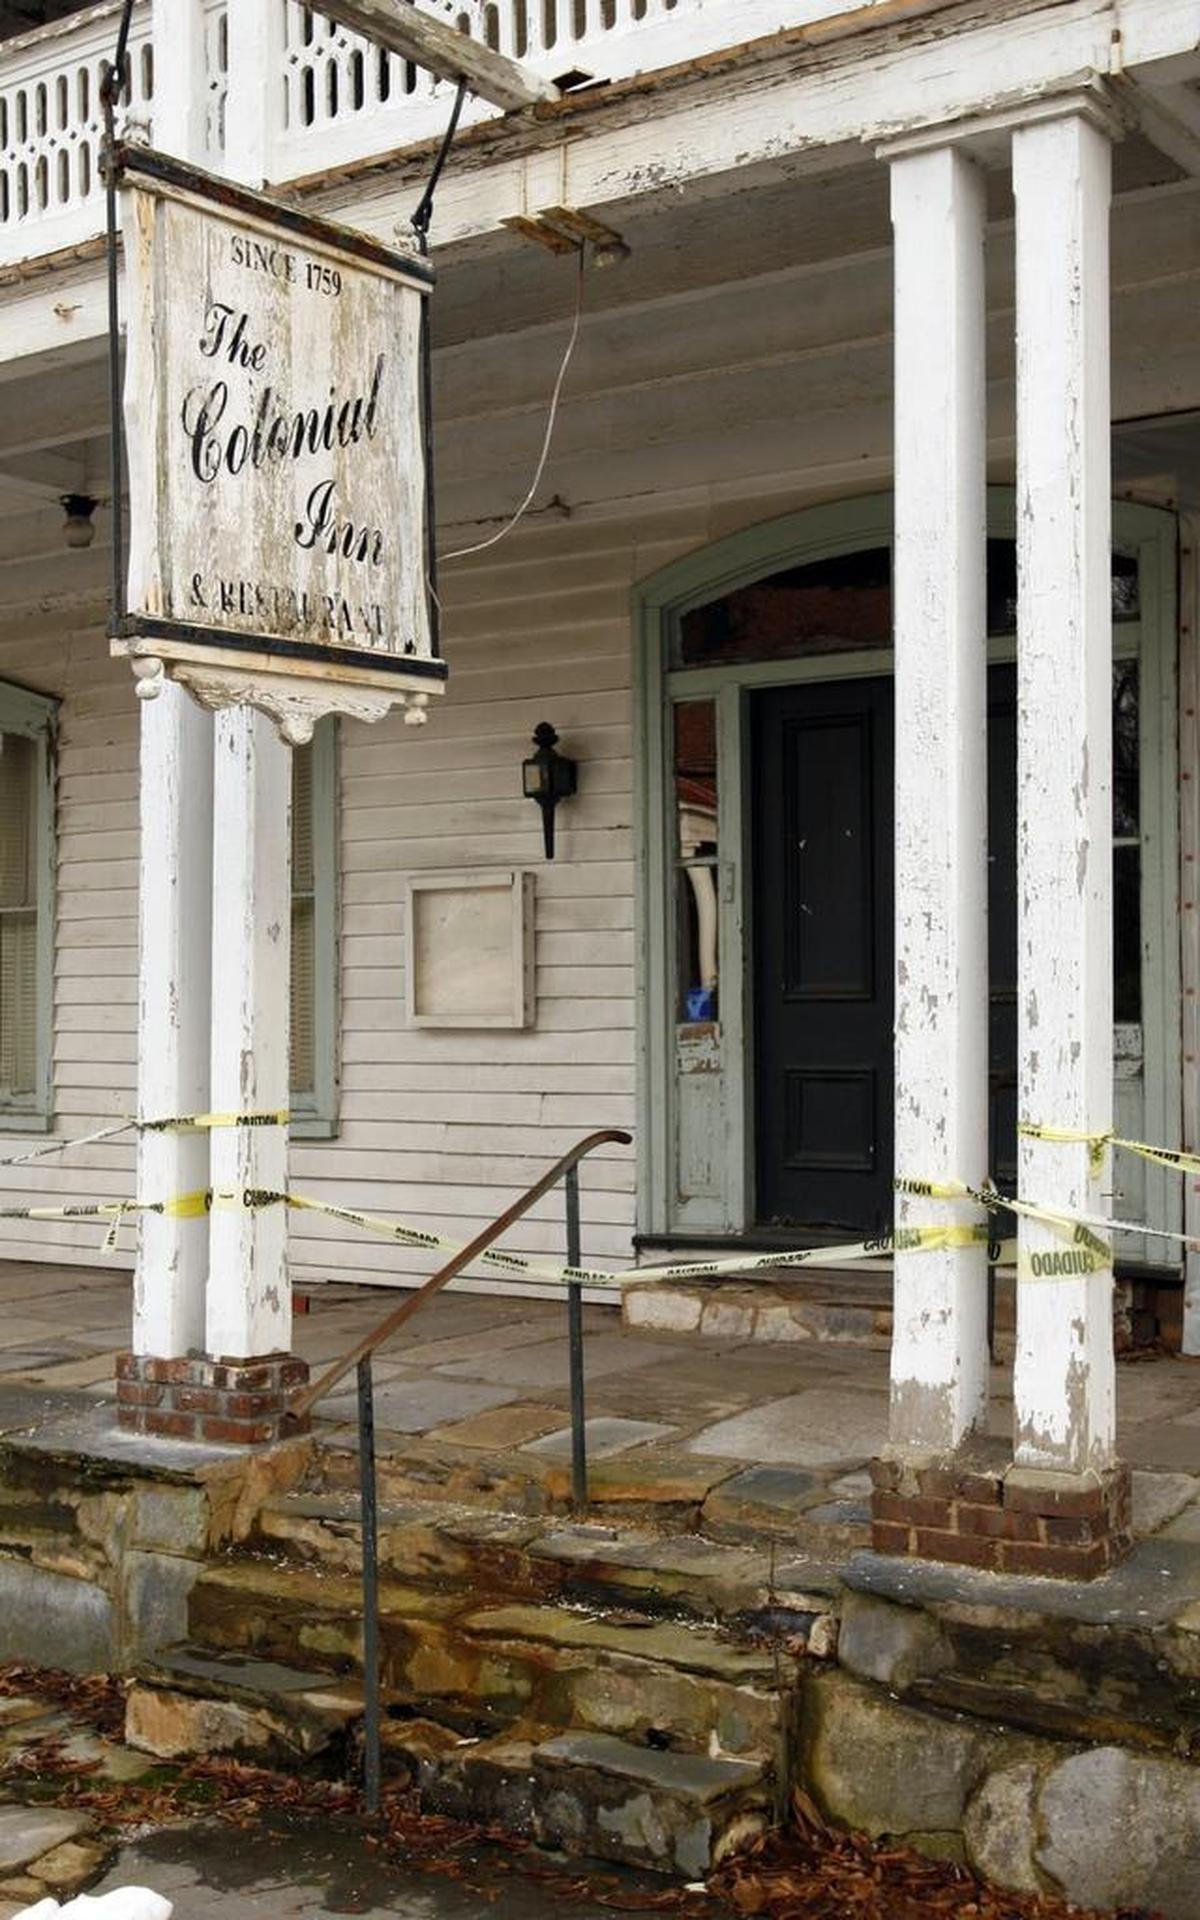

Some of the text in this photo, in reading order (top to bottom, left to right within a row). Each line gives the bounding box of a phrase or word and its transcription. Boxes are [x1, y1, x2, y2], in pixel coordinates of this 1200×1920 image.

[230, 235, 342, 297] SINCE 1759
[199, 302, 267, 372] The
[181, 353, 386, 484] Colonial
[294, 479, 384, 567] Inn
[189, 573, 208, 608] &
